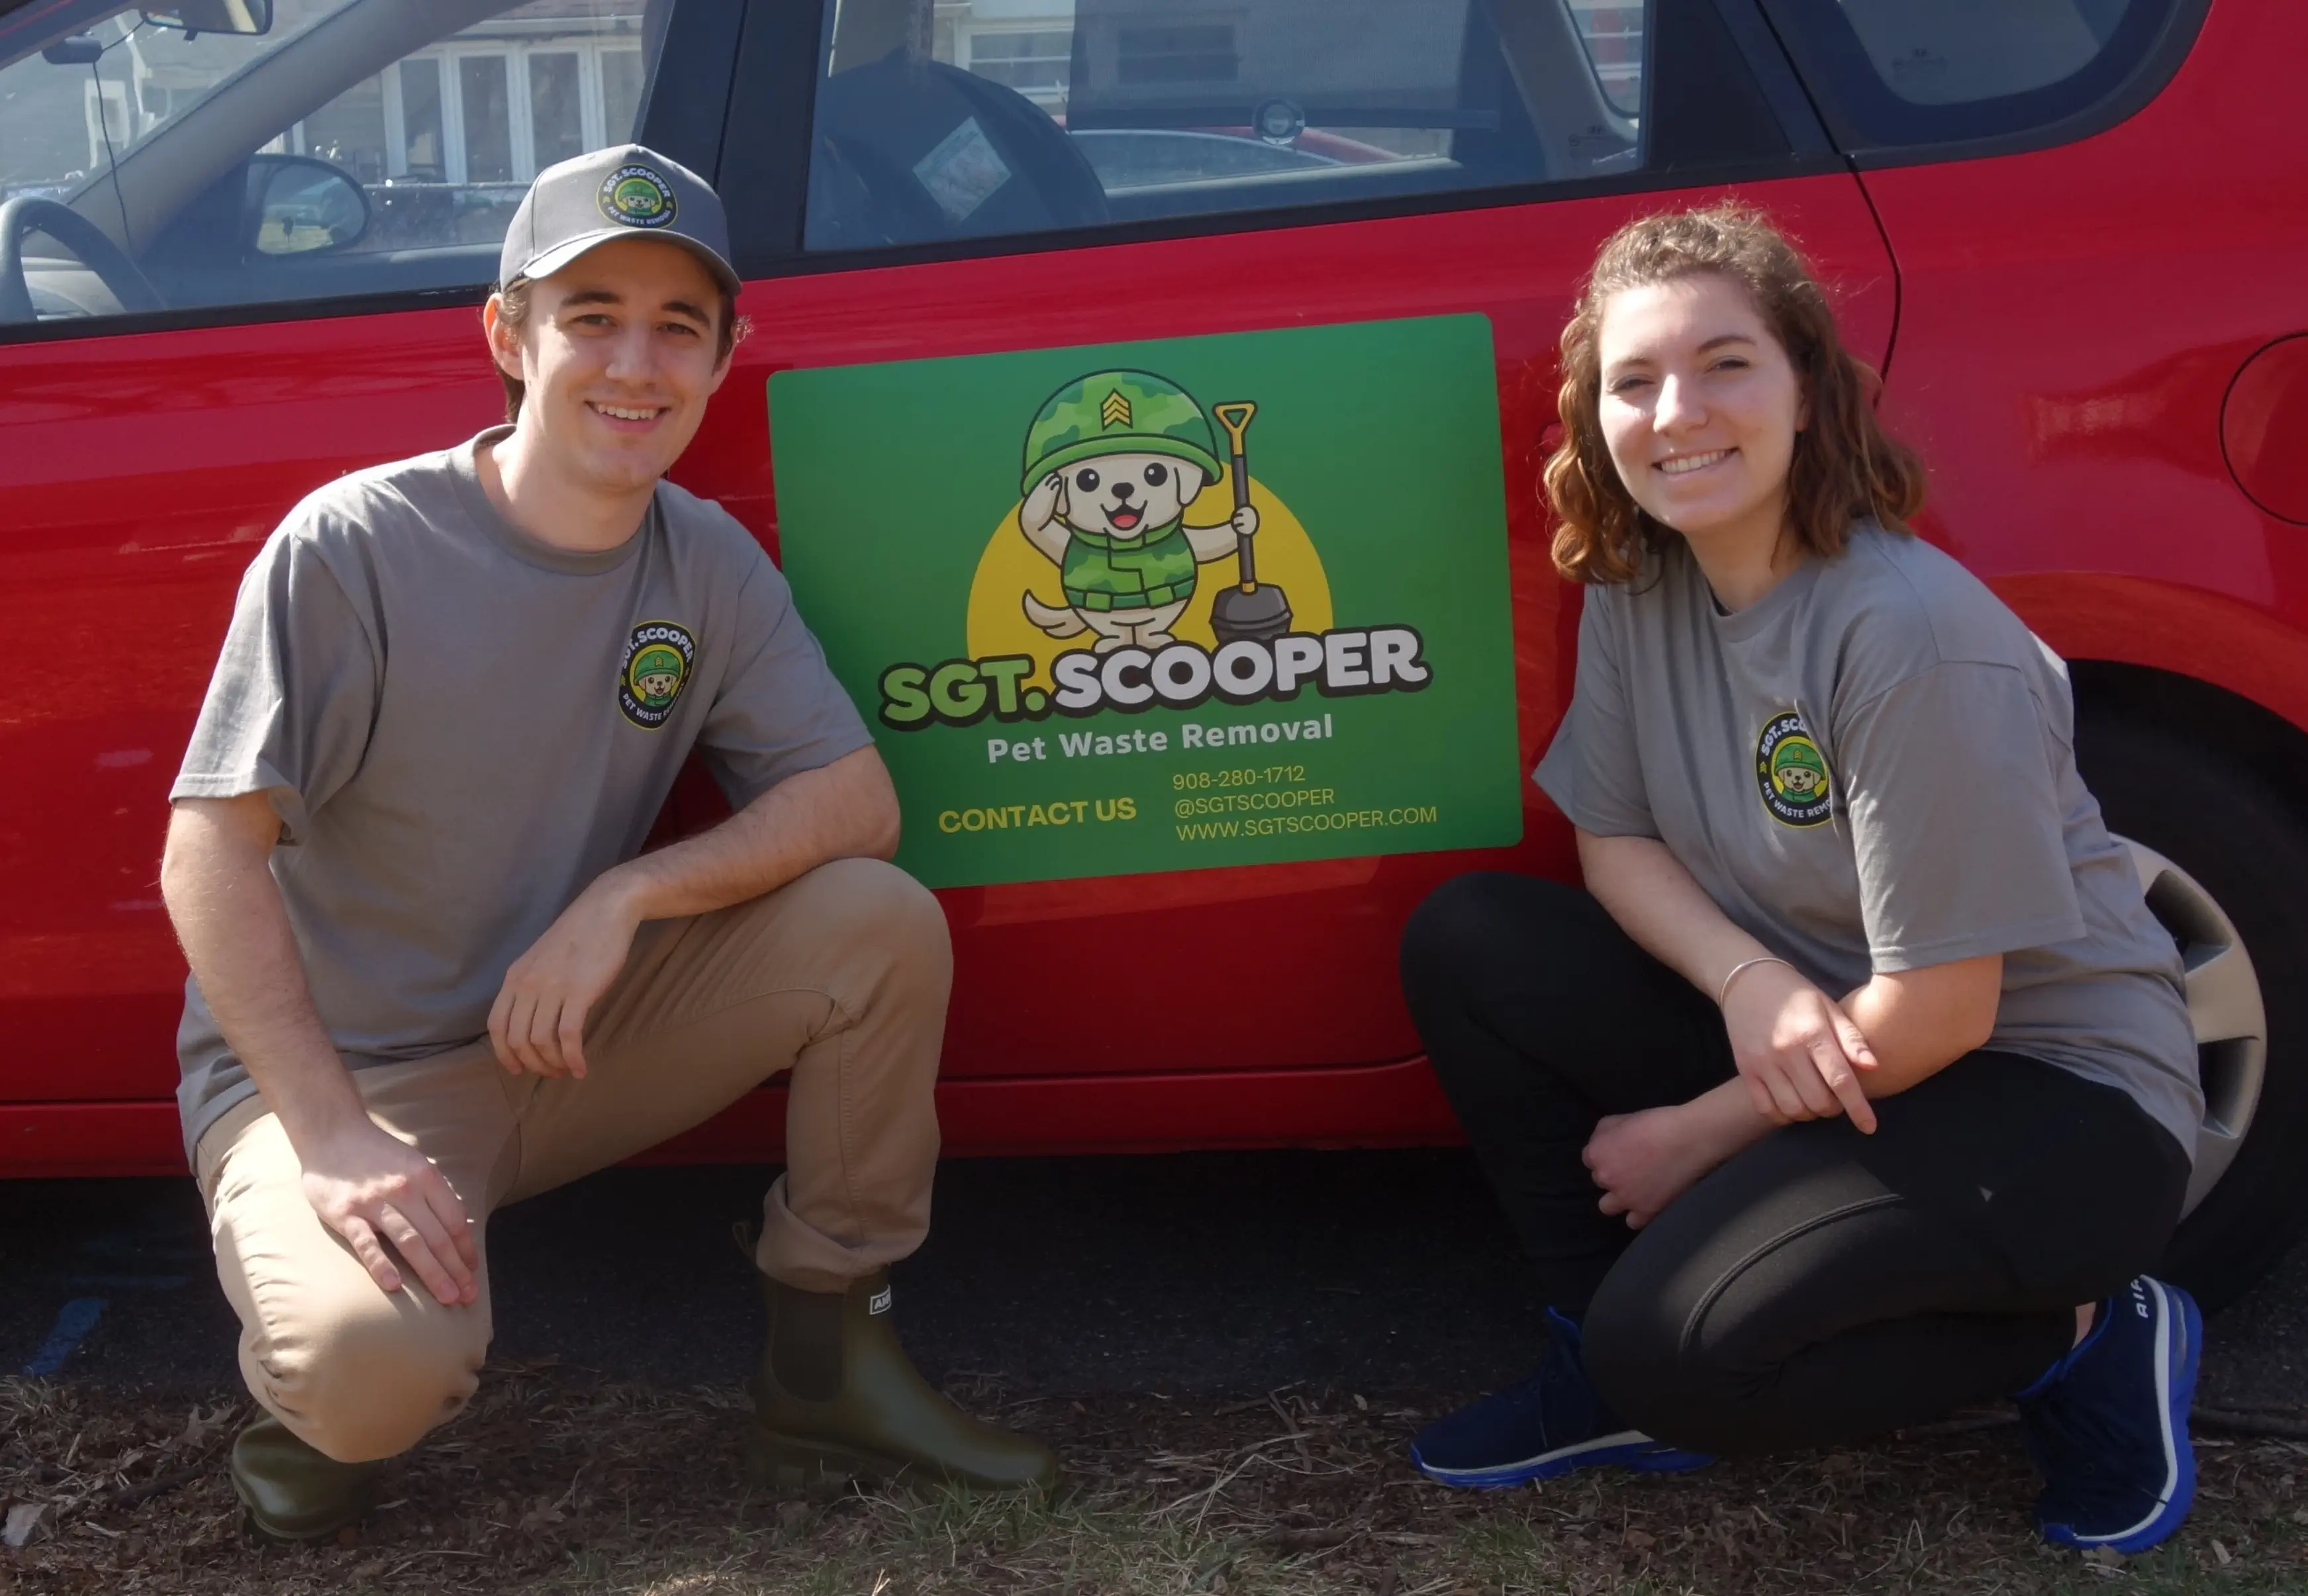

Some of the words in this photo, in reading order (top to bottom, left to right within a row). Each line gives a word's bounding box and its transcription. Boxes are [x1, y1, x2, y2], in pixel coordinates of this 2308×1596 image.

[623, 693, 636, 710] PET
[636, 708, 662, 721] WASTE
[987, 737, 1047, 763] Pet
[1058, 729, 1168, 757] Waste
[1182, 713, 1333, 749] Removal
[1173, 765, 1306, 791] 908-280-1712
[939, 801, 1088, 833] CONTACT
[1095, 797, 1137, 821] US
[1175, 788, 1335, 818] @SGTSCOOPER
[1764, 782, 1776, 800] PET
[1774, 800, 1805, 818] WASTE
[1176, 806, 1437, 841] WWW.SGTSCOOPER.COM
